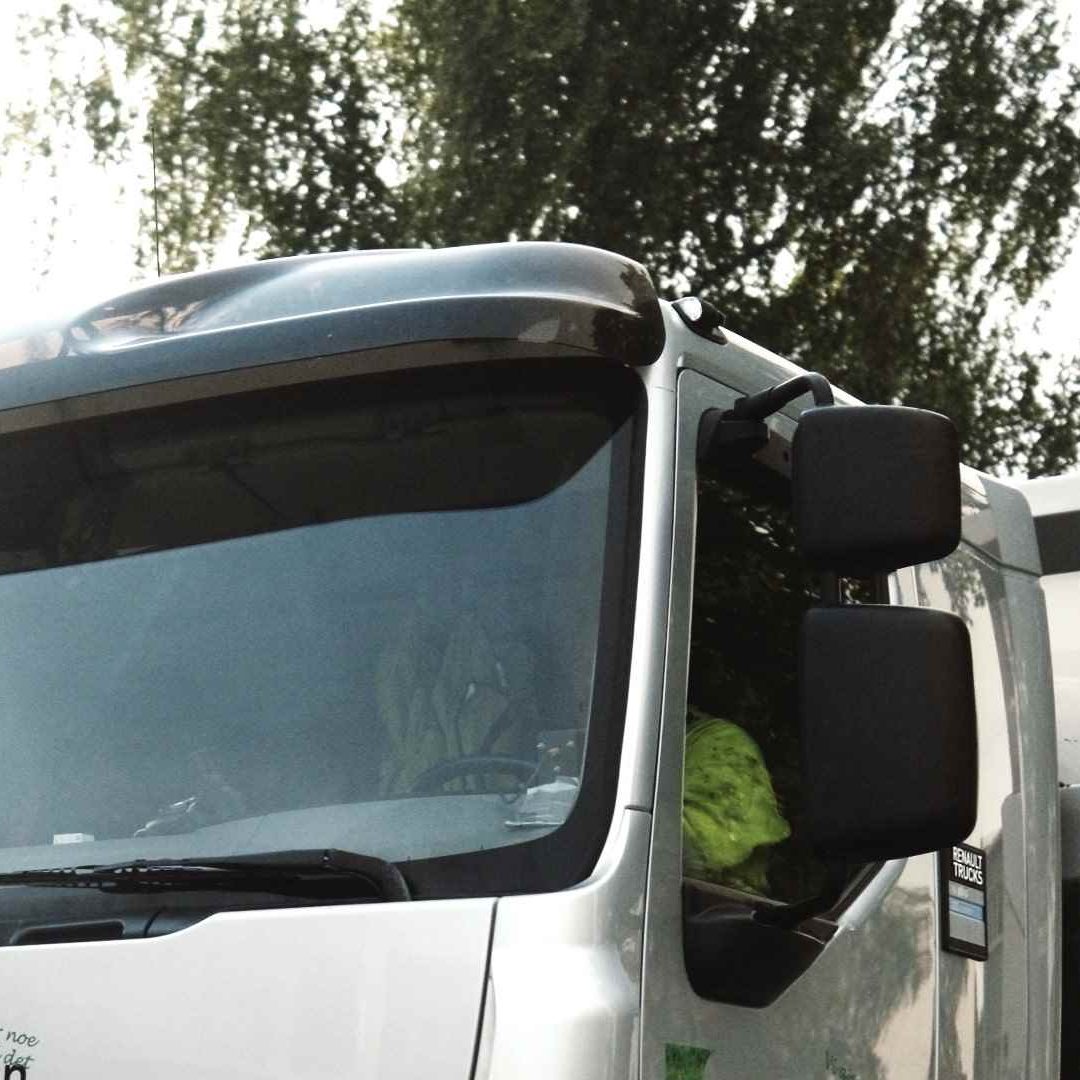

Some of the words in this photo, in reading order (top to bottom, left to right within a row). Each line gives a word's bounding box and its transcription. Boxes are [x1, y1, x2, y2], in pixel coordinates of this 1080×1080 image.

[952, 846, 983, 870] RENAULT
[952, 861, 983, 885] TRUCKS
[6, 1031, 40, 1047] noe
[4, 1049, 35, 1069] det
